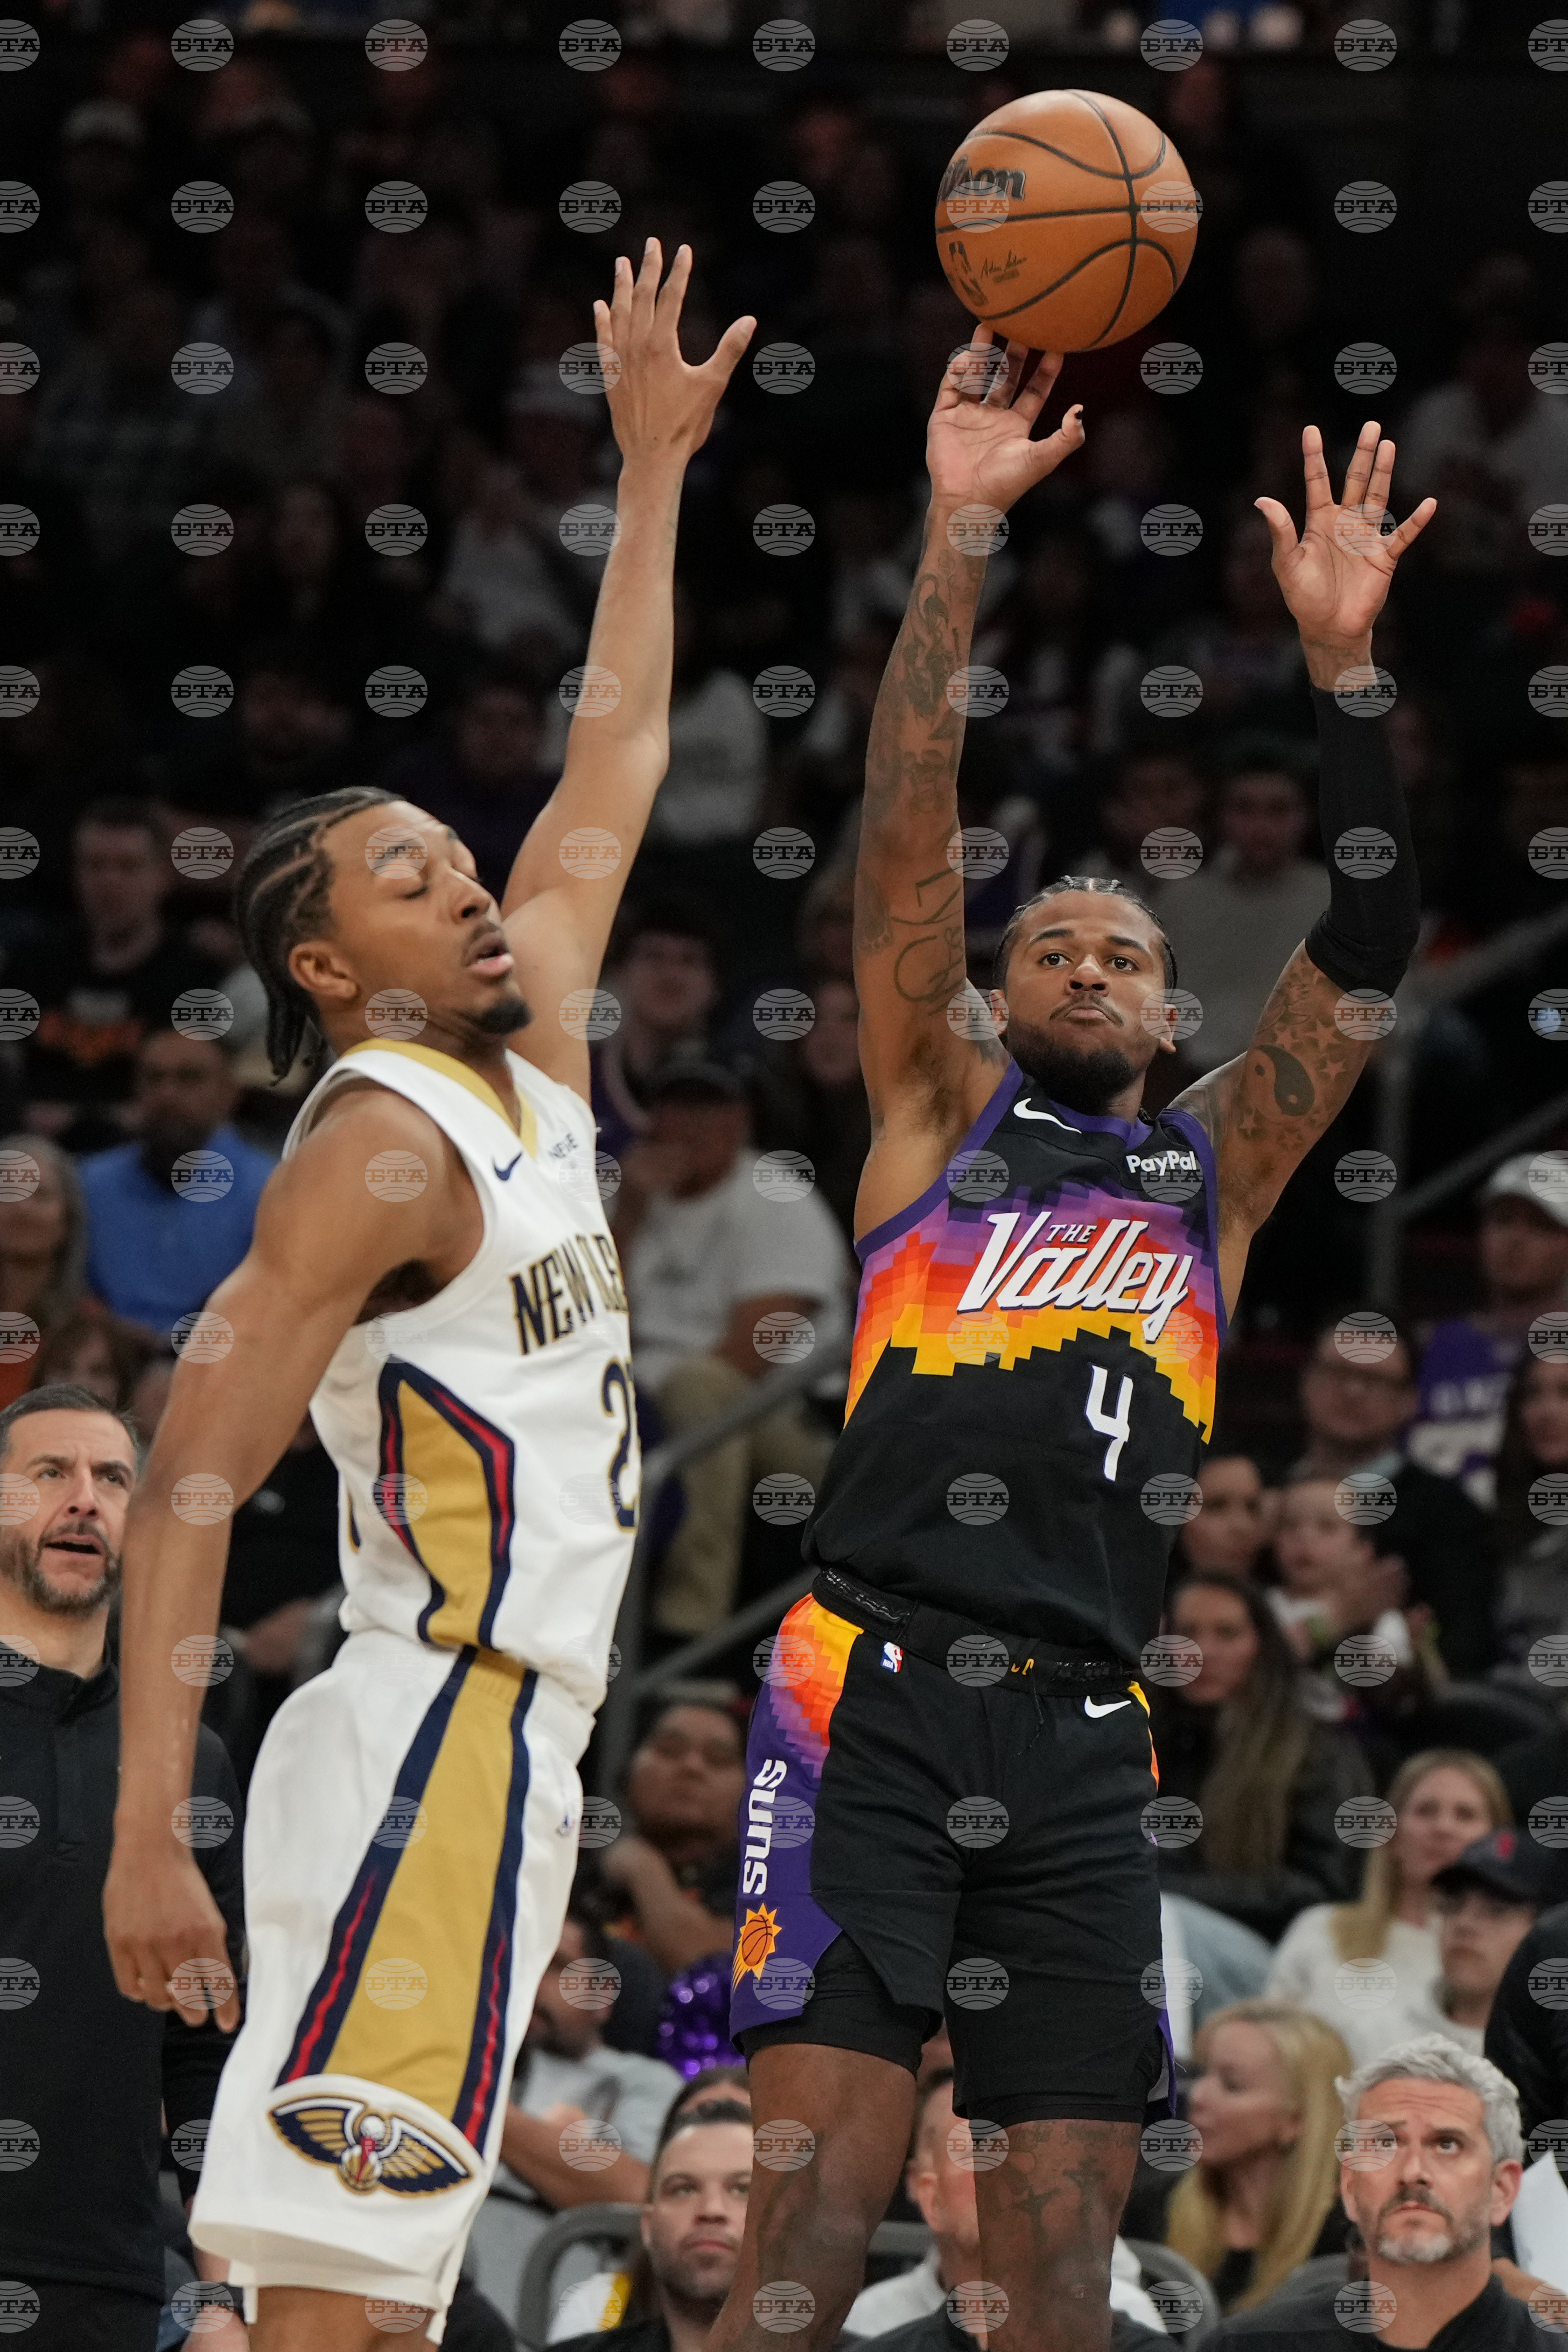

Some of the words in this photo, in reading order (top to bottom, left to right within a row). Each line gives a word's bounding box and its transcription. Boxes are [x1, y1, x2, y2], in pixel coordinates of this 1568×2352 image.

[1126, 1150, 1196, 1176] PayPal
[957, 1211, 1193, 1343] Valley
[1046, 1224, 1097, 1243] THE
[509, 1240, 595, 1356] NEW
[599, 1357, 641, 1534] 2
[1084, 1362, 1134, 1482] 4
[882, 1659, 894, 1669] NBA
